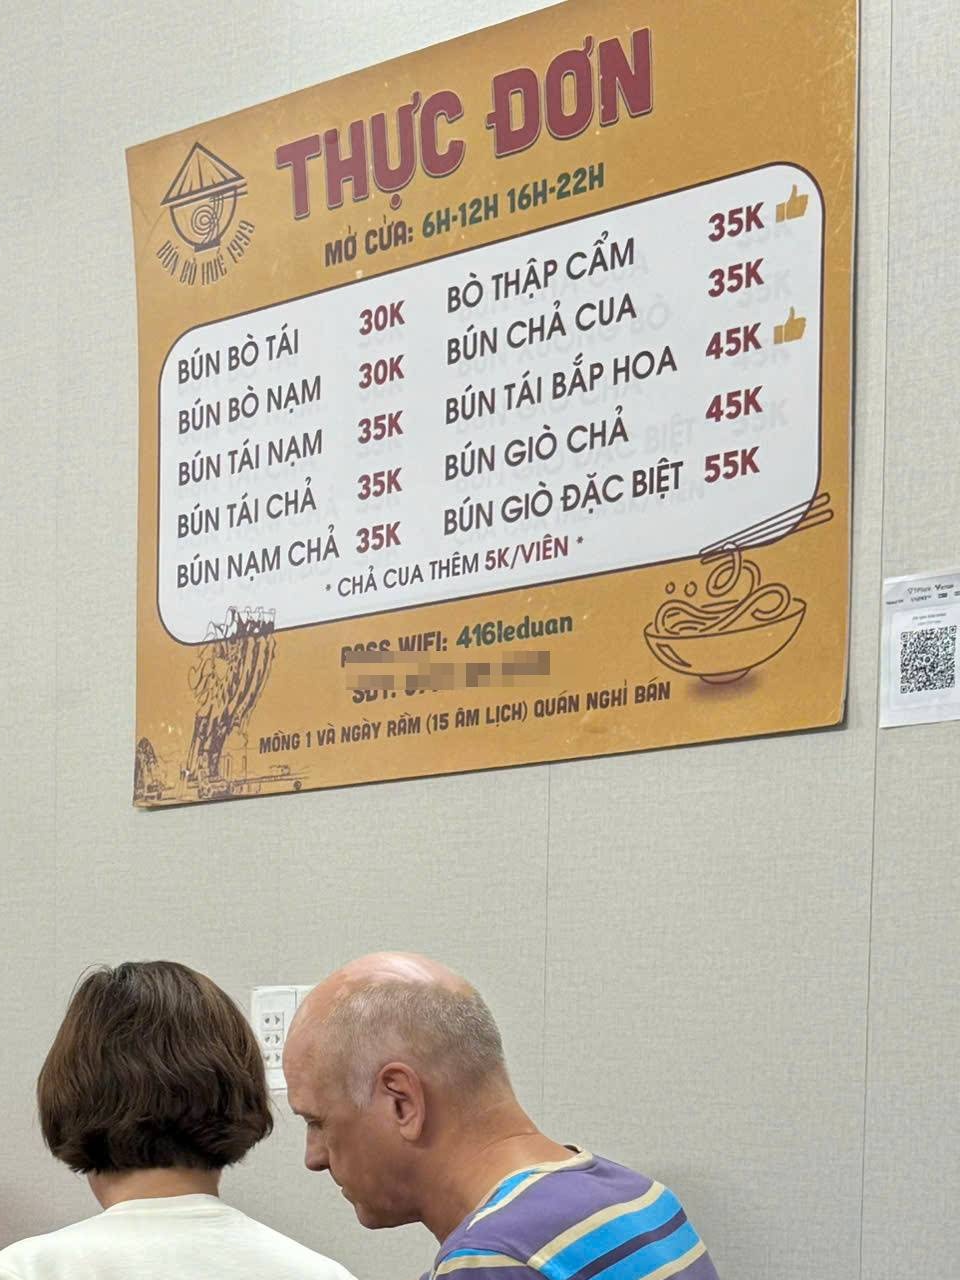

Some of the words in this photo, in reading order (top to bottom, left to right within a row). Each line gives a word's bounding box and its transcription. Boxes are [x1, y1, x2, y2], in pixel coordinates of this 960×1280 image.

[276, 91, 467, 220] THỰC
[486, 28, 653, 159] ĐƠN
[325, 226, 357, 267] MỞ
[365, 215, 413, 255] CỬA:
[423, 193, 498, 238] 6H-12H
[507, 162, 604, 213] 16H-22H
[448, 273, 483, 313] BÒ
[492, 258, 557, 300] THẬP
[566, 231, 634, 280] CẨM
[709, 202, 764, 242] 35K
[179, 347, 220, 384] BÚN
[229, 334, 259, 371] BÒ
[266, 323, 298, 360] TÁI
[359, 300, 405, 335] 30K
[448, 324, 497, 365] BÚN
[507, 300, 566, 348] CHẢ
[575, 293, 637, 329] CUA
[708, 258, 764, 297] 35K
[179, 398, 220, 434] BÚN
[229, 385, 259, 422] BÒ
[267, 376, 320, 413] NẠM
[359, 355, 404, 389] 30K
[446, 384, 495, 424] BÚN
[504, 370, 541, 410] TÁI
[553, 353, 603, 399] BẮP
[613, 346, 677, 385] HOA
[706, 323, 761, 359] 45K
[179, 450, 220, 486] BÚN
[228, 439, 259, 474] TÁI
[268, 429, 322, 466] NẠM
[358, 410, 403, 444] 35K
[446, 441, 495, 481] BÚN
[505, 425, 557, 467] GIÒ
[567, 405, 629, 453] CHẢ
[706, 386, 762, 422] 45K
[178, 503, 219, 538] BÚN
[227, 493, 258, 528] TÁI
[267, 477, 316, 519] CHẢ
[358, 468, 402, 500] 35K
[444, 497, 493, 535] BÚN
[501, 481, 553, 523] GIÒ
[560, 472, 624, 514] ĐẶC
[632, 458, 683, 498] BIỆT
[705, 446, 760, 483] 55K
[177, 554, 219, 588] BÚN
[228, 546, 280, 581] NẠM
[288, 524, 339, 566] CHẢ
[356, 521, 401, 553] 35K
[338, 565, 377, 597] CHẢ
[383, 565, 424, 588] CUA
[429, 552, 478, 580] THÊM
[485, 534, 568, 570] 5K/VIÊN
[398, 631, 448, 652] WIFI:
[456, 616, 572, 648] 416leduan
[306, 731, 311, 747] 1
[317, 723, 335, 746] VÀ
[341, 718, 381, 743] NGÀY
[426, 713, 449, 734] (15
[455, 708, 479, 728] ÂM
[486, 701, 527, 727] LỊCH)
[534, 691, 579, 717] QUÁN
[587, 680, 627, 710] NGHỈ
[635, 677, 670, 704] BÁN
